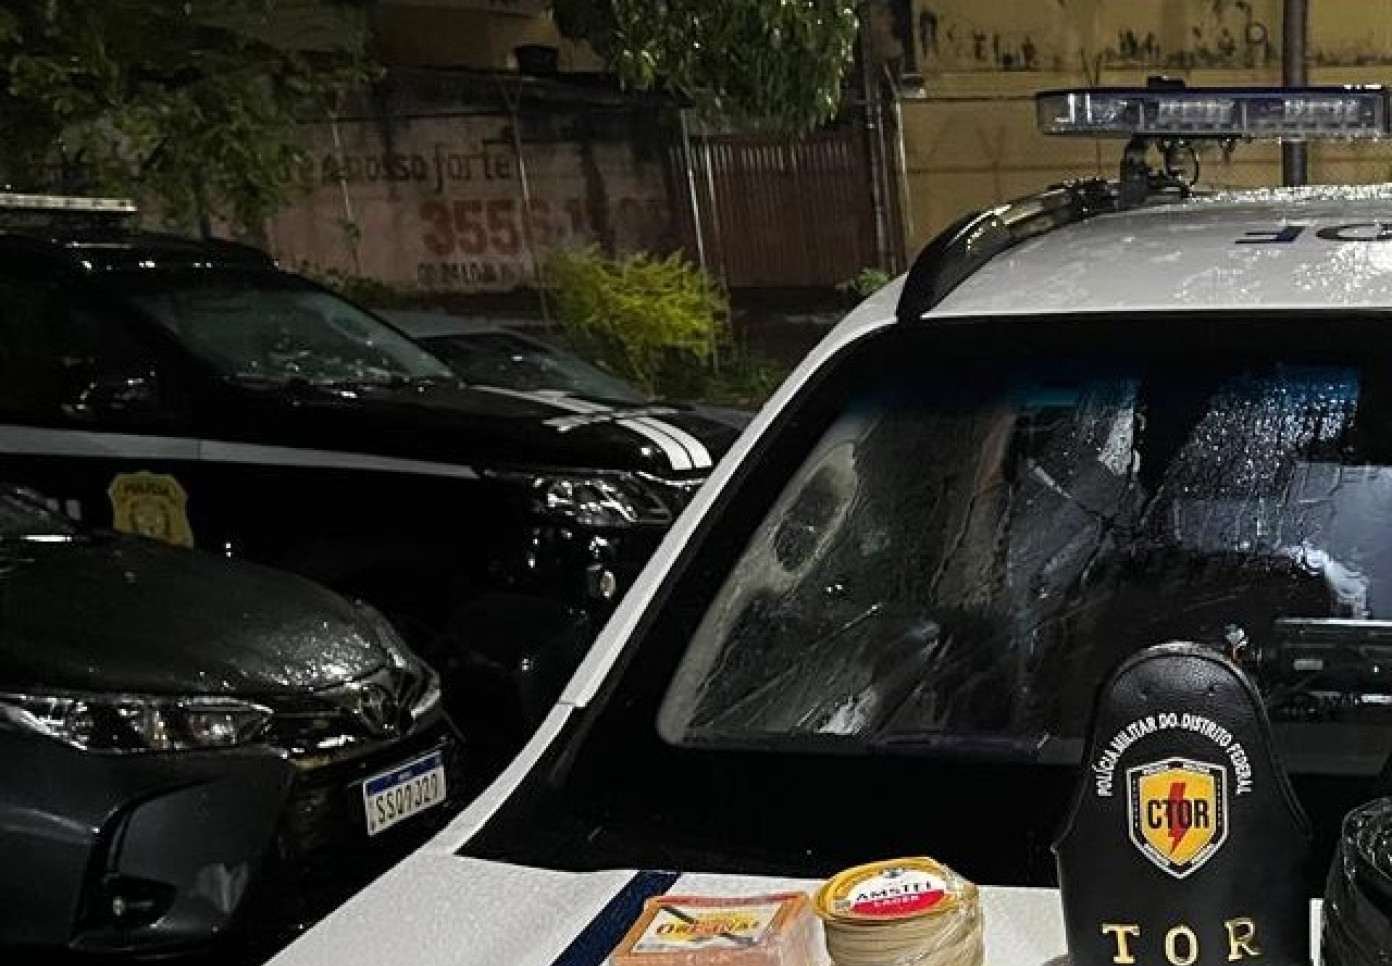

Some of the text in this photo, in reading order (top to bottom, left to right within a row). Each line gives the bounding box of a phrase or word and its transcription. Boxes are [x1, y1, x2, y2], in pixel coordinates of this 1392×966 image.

[1110, 715, 1157, 753] MILITAR
[1158, 712, 1178, 729] DO
[1182, 712, 1232, 747] DISTRITO
[1147, 799, 1210, 831] CTOR
